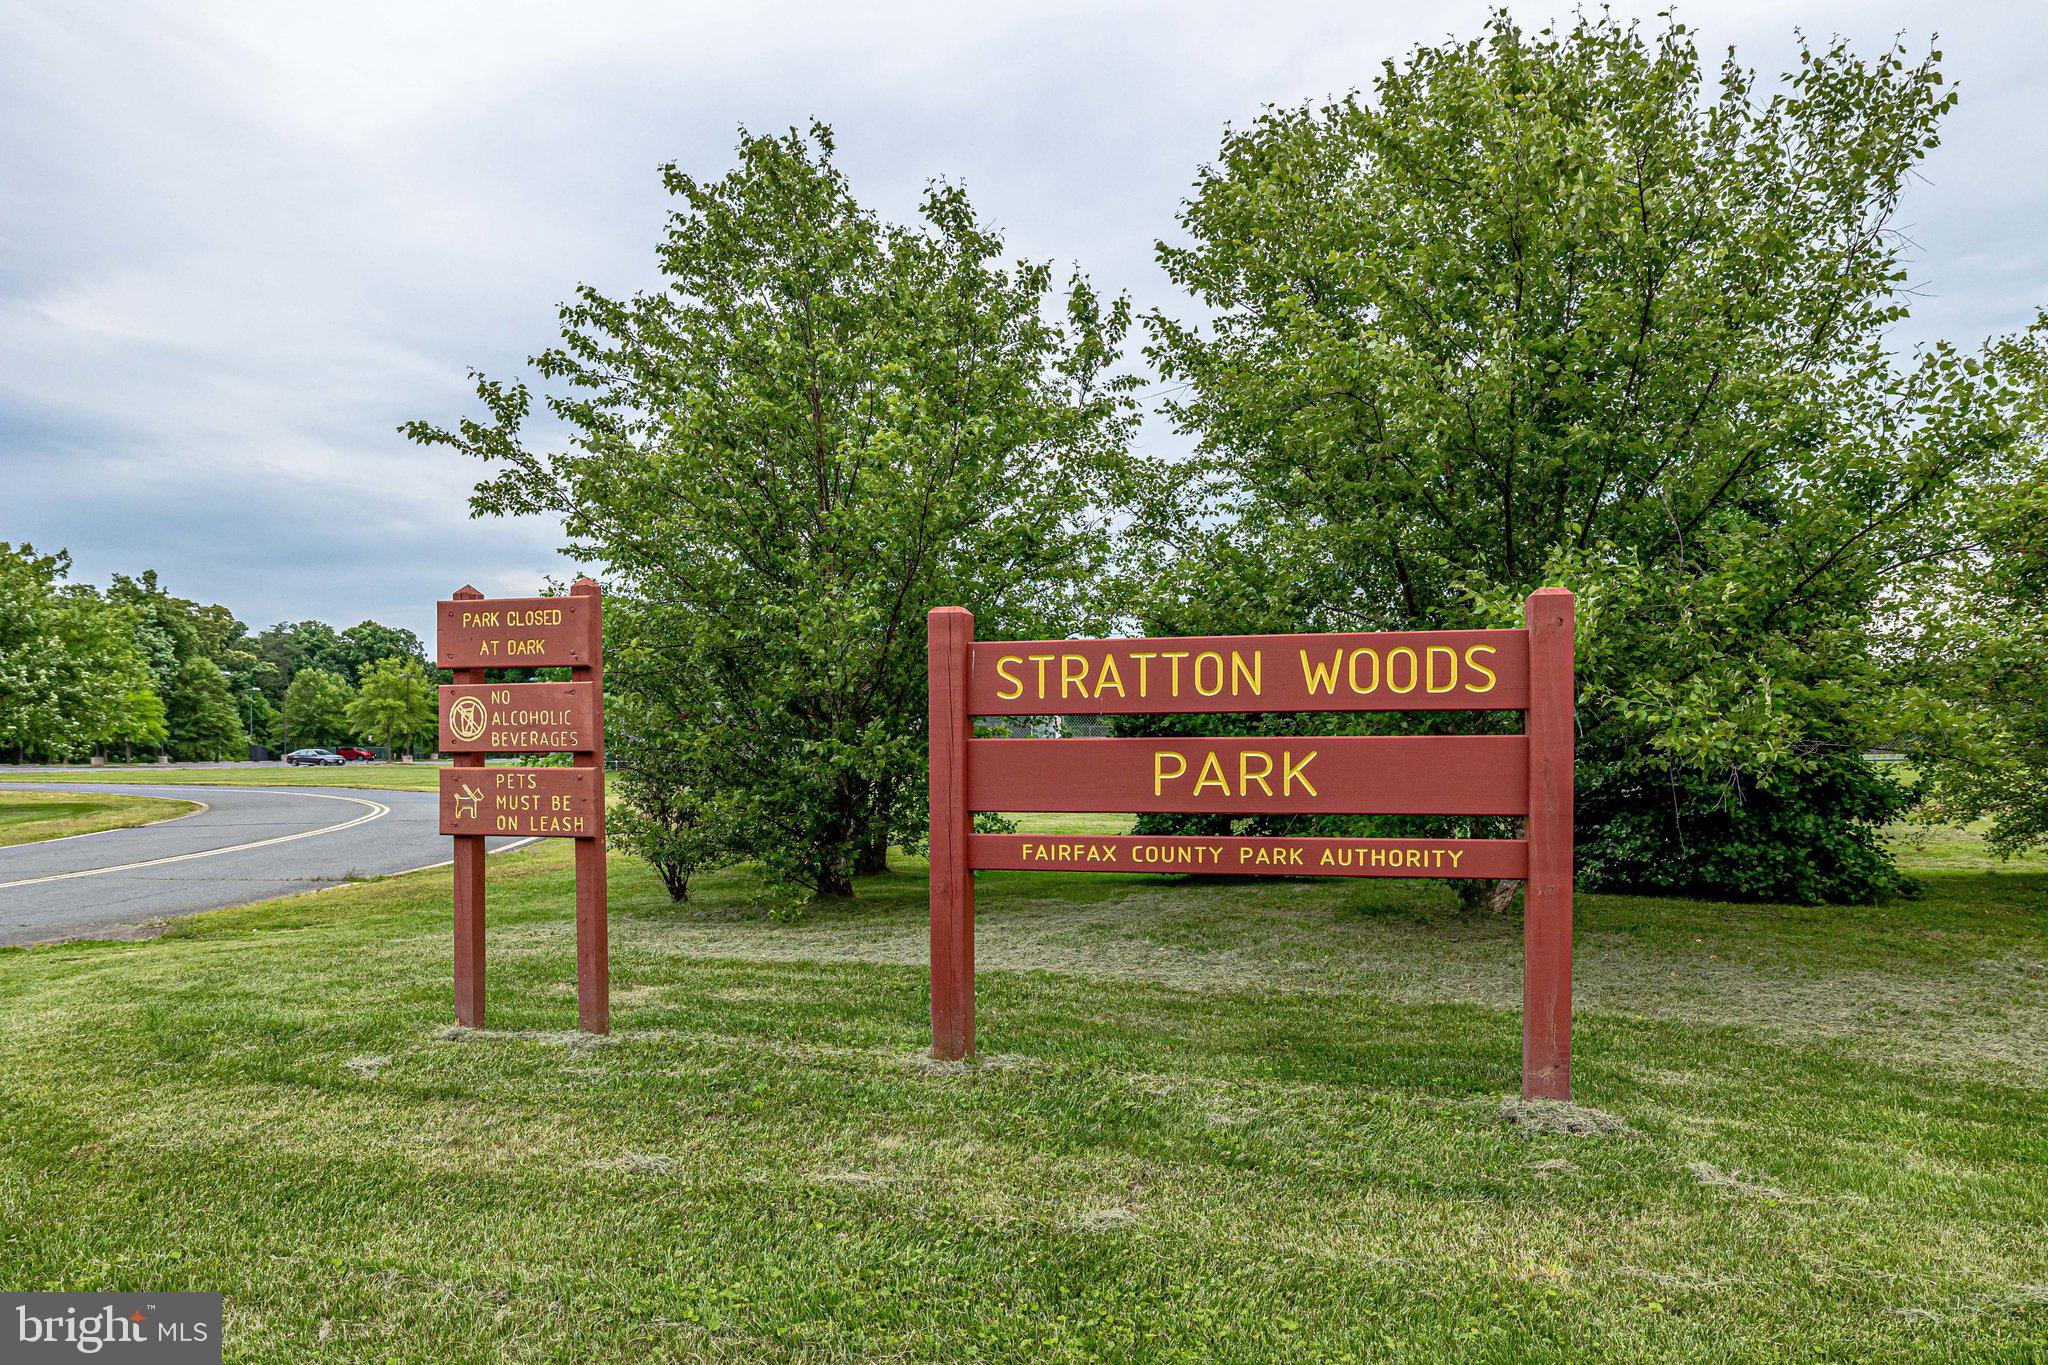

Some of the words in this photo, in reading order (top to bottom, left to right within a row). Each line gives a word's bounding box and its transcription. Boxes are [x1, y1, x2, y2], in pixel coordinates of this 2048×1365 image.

[462, 611, 500, 628] PARK
[506, 609, 562, 627] CLOSED
[479, 639, 500, 656] AT
[507, 639, 546, 656] DARK
[996, 650, 1262, 700] STRATTON
[1299, 644, 1497, 695] WOODS
[491, 689, 511, 705] NO
[491, 709, 572, 726] ALCOHOLIC
[491, 730, 578, 748] BEVERAGES
[496, 773, 537, 789] PETS
[1154, 750, 1318, 797] PARK
[496, 794, 541, 811] MUST
[551, 795, 572, 812] BE
[496, 814, 518, 831] ON
[530, 815, 584, 833] LEASH
[1022, 843, 1117, 862] FAIRFAX
[1132, 845, 1224, 864] COUNTY
[1240, 846, 1304, 866] PARK
[1319, 848, 1464, 868] AUTHORITY
